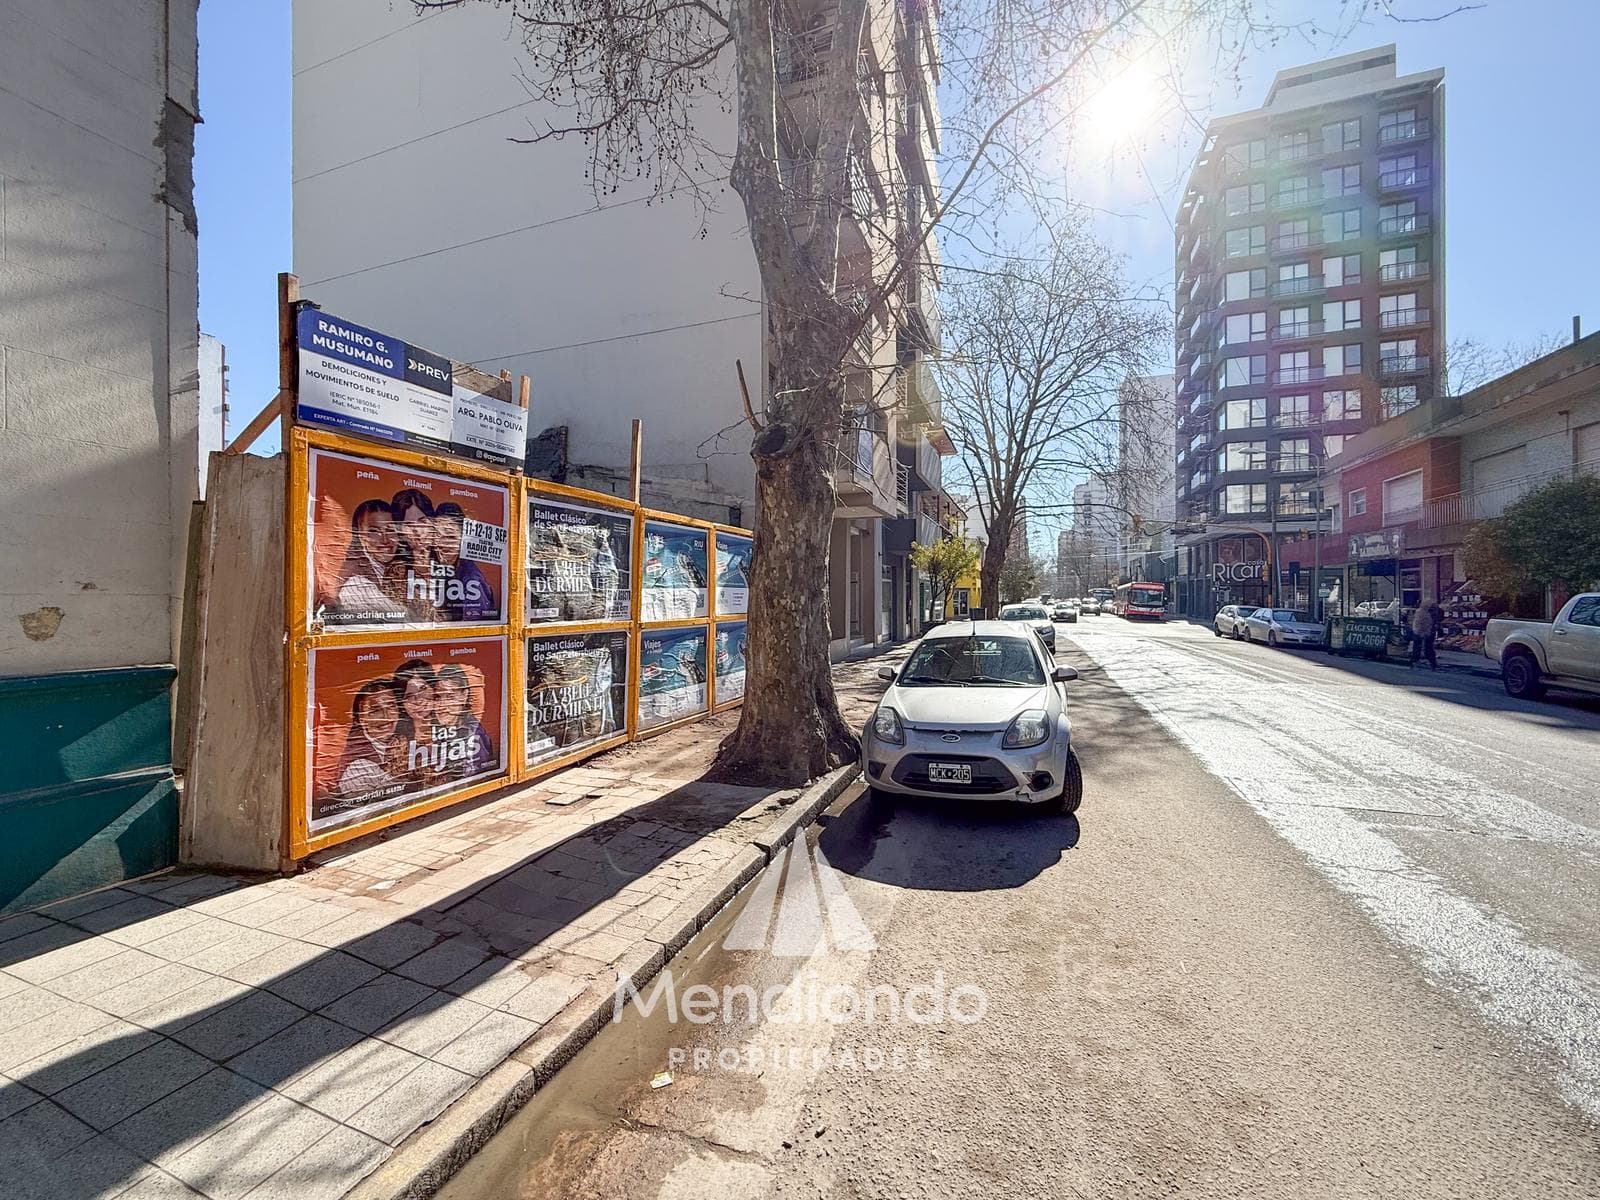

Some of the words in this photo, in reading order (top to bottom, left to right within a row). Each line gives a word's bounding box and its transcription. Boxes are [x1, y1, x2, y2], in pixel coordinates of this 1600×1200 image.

[318, 319, 374, 348] RAMIRO
[375, 341, 389, 353] G.
[312, 334, 394, 369] MUSUMANO
[321, 360, 380, 385] DEMOLICIONES
[417, 362, 450, 382] PREV
[305, 369, 364, 392] MOVIMIENTOS
[365, 386, 375, 395] DE
[376, 390, 400, 402] SUELO
[458, 406, 477, 419] ARQ.
[479, 412, 502, 426] PABLO
[503, 420, 523, 433] OLIVA
[356, 469, 379, 481] peña
[403, 478, 433, 491] villamil
[449, 487, 479, 499] gamboa
[533, 520, 545, 529] de
[534, 509, 559, 520] Ballet
[559, 513, 587, 525] Clásico
[466, 542, 488, 553] RADIO
[488, 546, 504, 556] CITY
[693, 540, 704, 549] RIU
[430, 559, 456, 578] las
[1212, 562, 1261, 582] RiCar
[406, 568, 482, 608] hijas
[356, 610, 385, 619] adrián
[385, 611, 406, 619] suar
[533, 641, 559, 652] Ballet
[559, 639, 585, 649] Clásico
[643, 639, 661, 650] Viajes
[356, 653, 380, 664] peña
[403, 649, 433, 658] villamil
[449, 647, 477, 657] gamboa
[533, 652, 545, 662] de
[431, 725, 457, 742] las
[408, 735, 482, 772] hijas
[385, 784, 407, 795] suar
